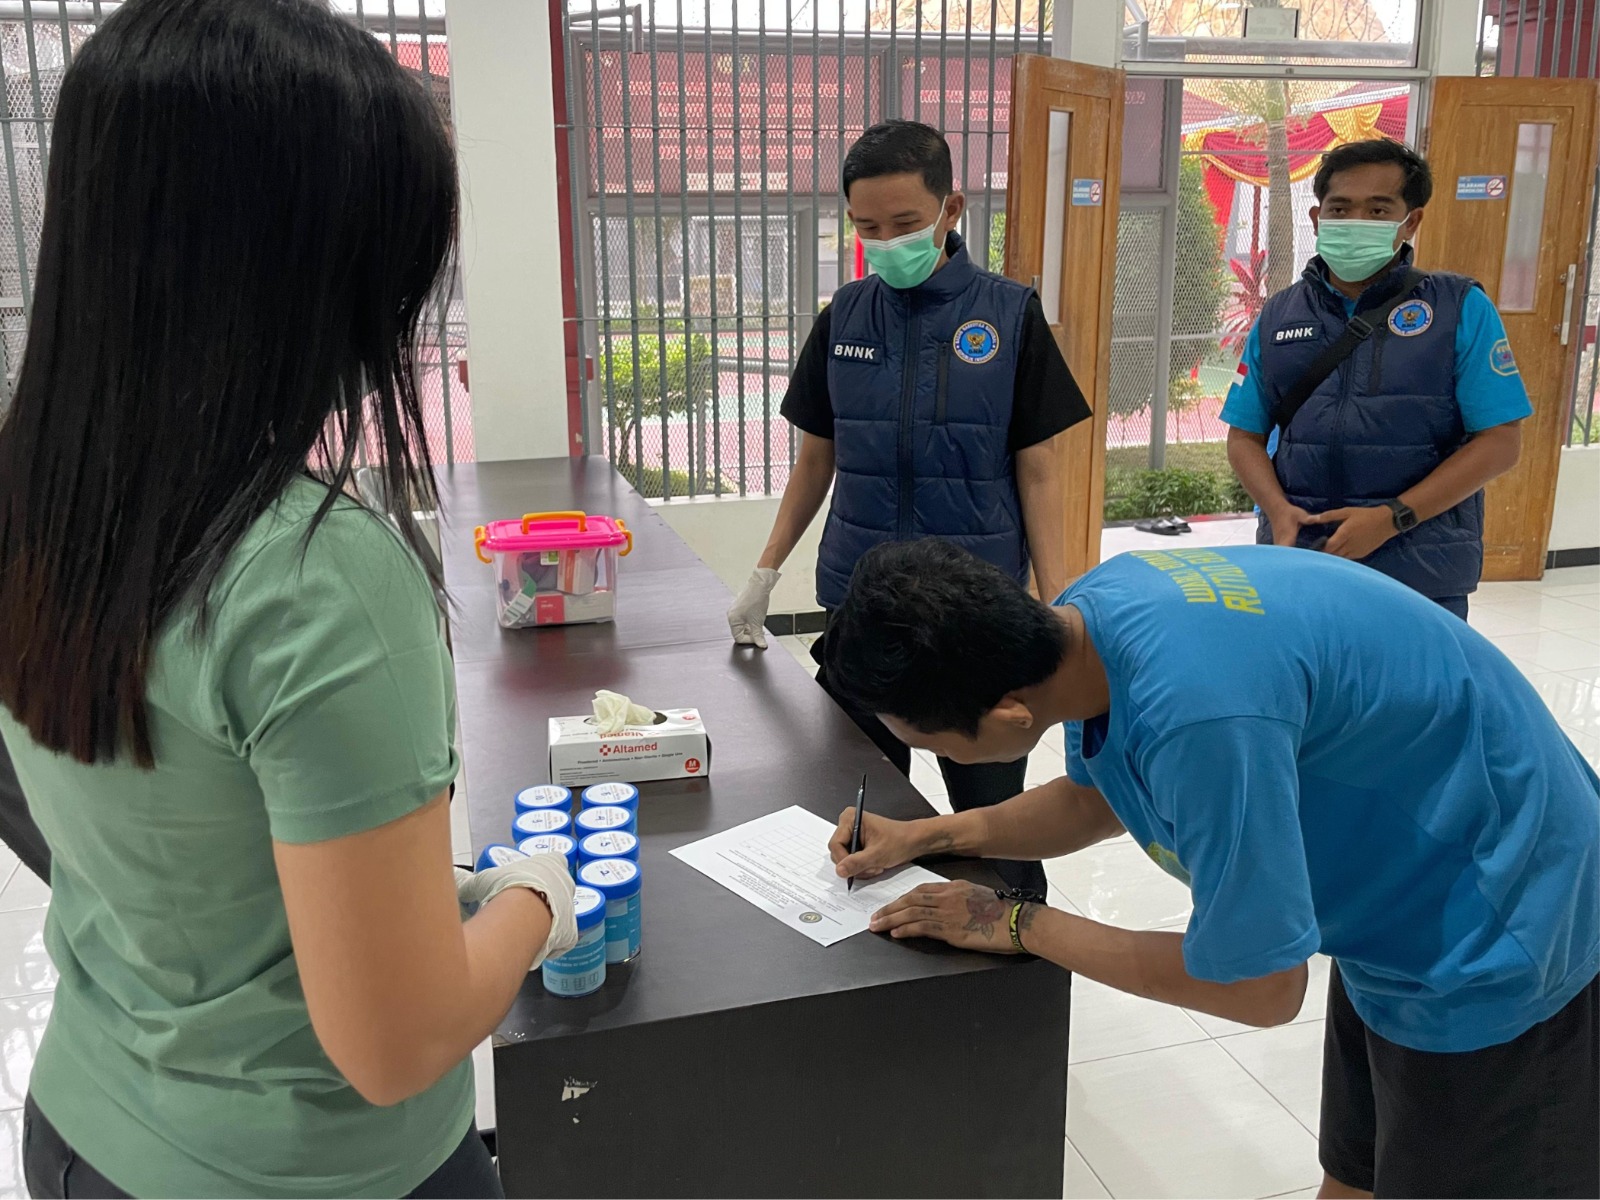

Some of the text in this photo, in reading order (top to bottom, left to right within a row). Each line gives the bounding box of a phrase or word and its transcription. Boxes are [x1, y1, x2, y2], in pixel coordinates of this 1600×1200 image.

[1276, 327, 1313, 340] BNNK
[834, 344, 875, 359] BNNK
[613, 742, 658, 754] Altamed
[688, 760, 697, 768] M
